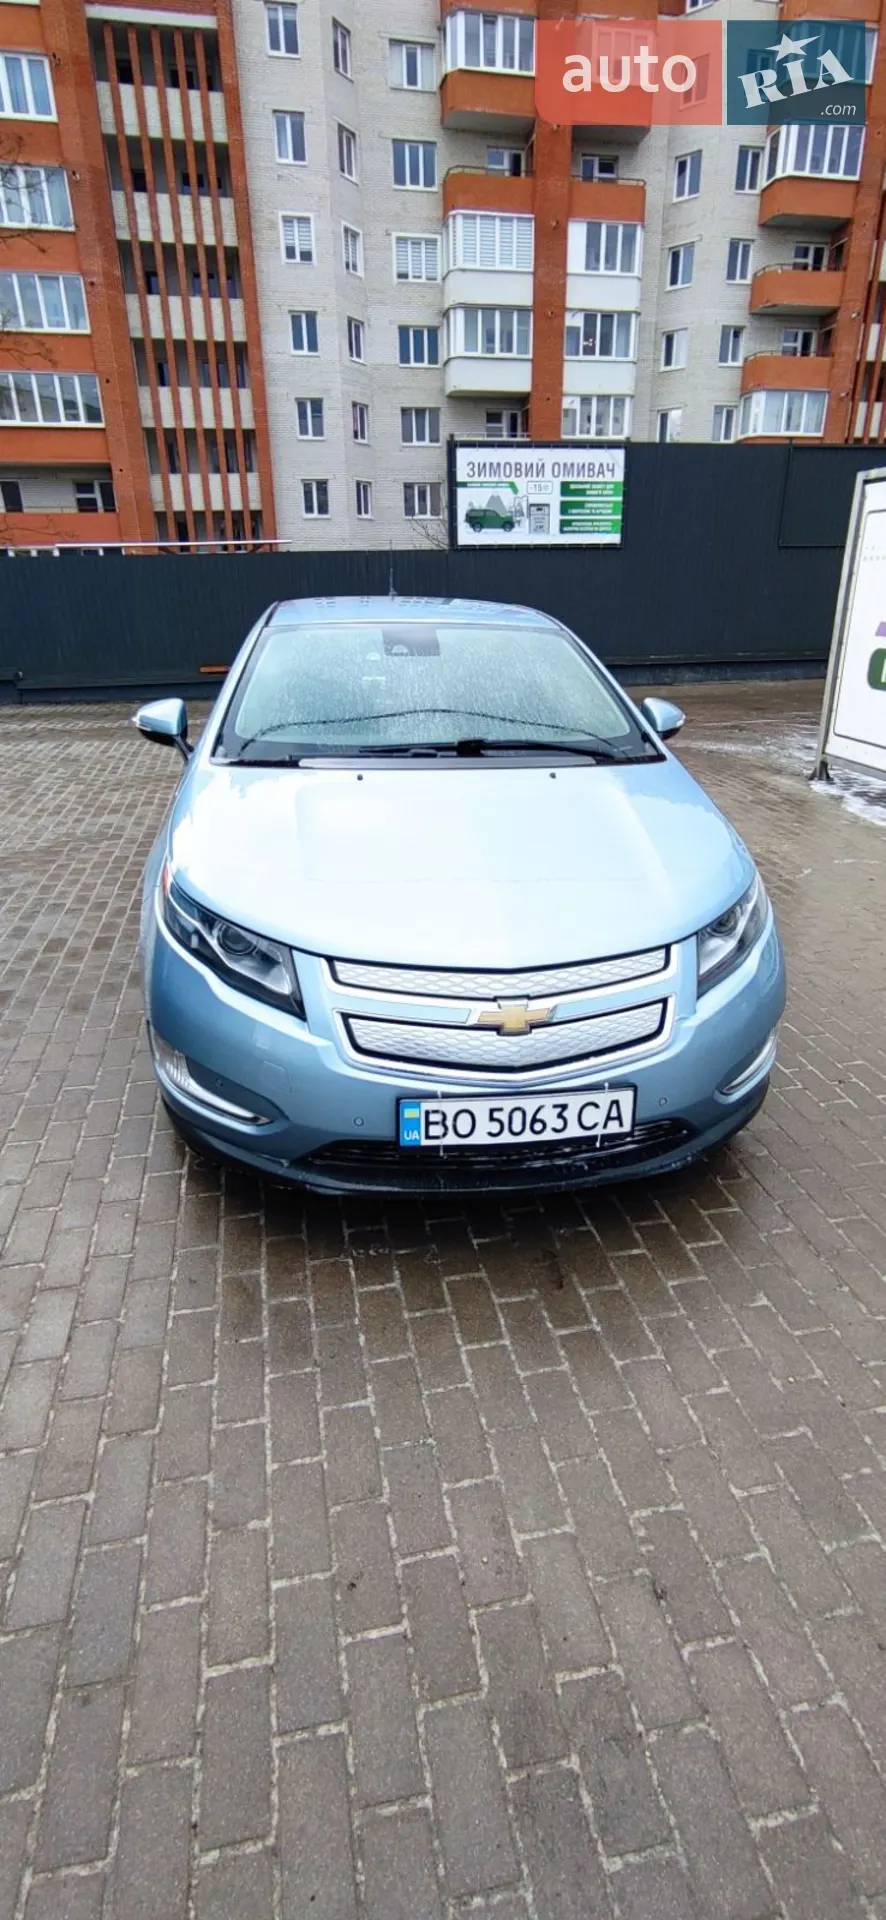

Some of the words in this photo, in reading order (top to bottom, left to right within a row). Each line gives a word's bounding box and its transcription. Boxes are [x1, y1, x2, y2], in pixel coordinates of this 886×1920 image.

[466, 458, 545, 478] ЗИМОВИЙ
[551, 461, 615, 478] ОМИВАЧ
[424, 1109, 476, 1140] BO
[487, 1103, 569, 1138] 5063
[577, 1099, 624, 1131] CA
[404, 1132, 420, 1141] UA
